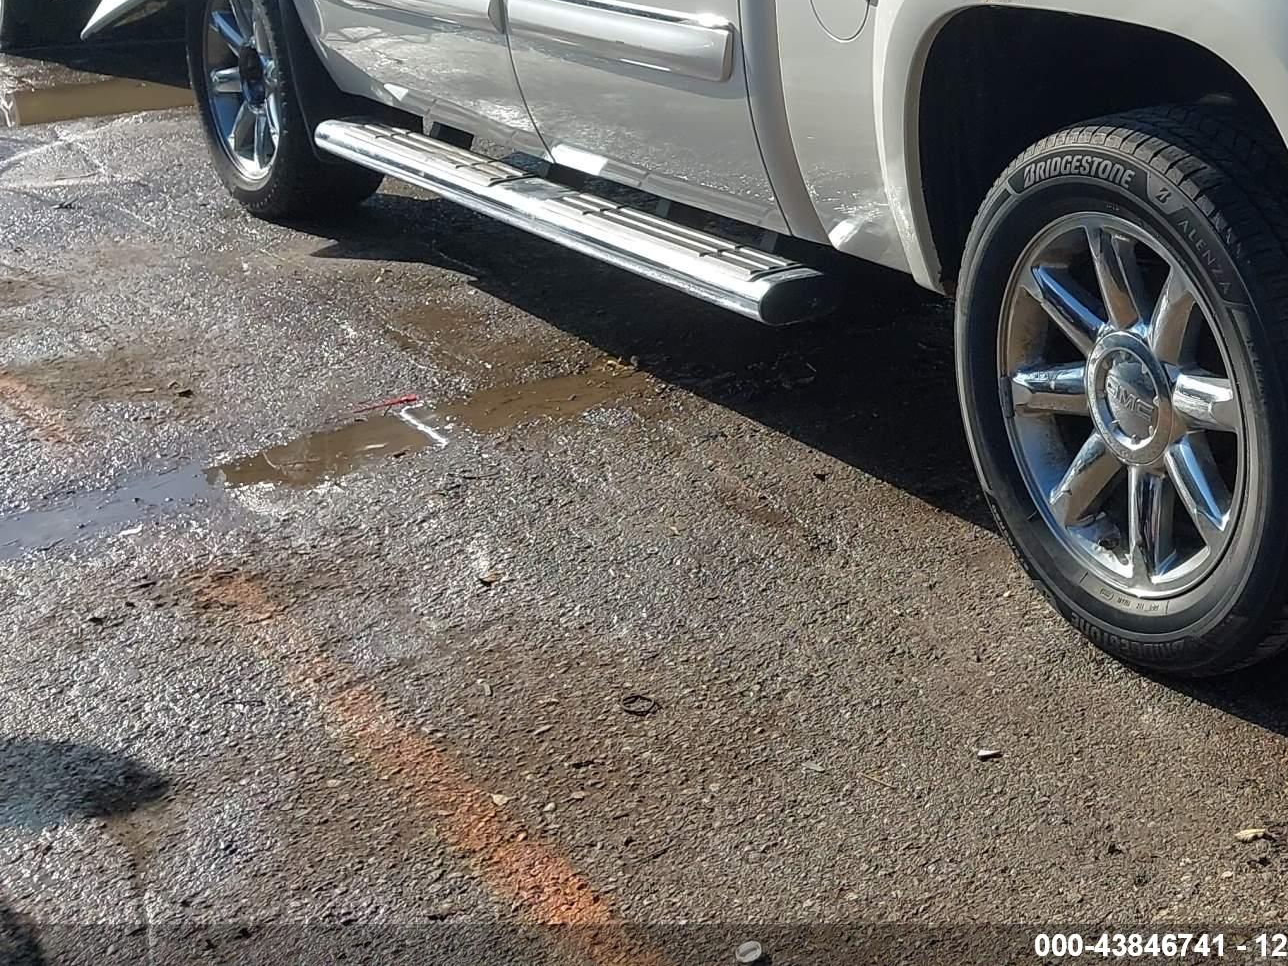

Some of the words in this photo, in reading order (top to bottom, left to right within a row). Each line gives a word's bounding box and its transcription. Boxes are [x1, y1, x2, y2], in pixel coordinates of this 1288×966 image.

[1023, 154, 1136, 189] BRIDGESTONE
[1177, 219, 1230, 295] ALENZA
[1105, 374, 1155, 421] GMC
